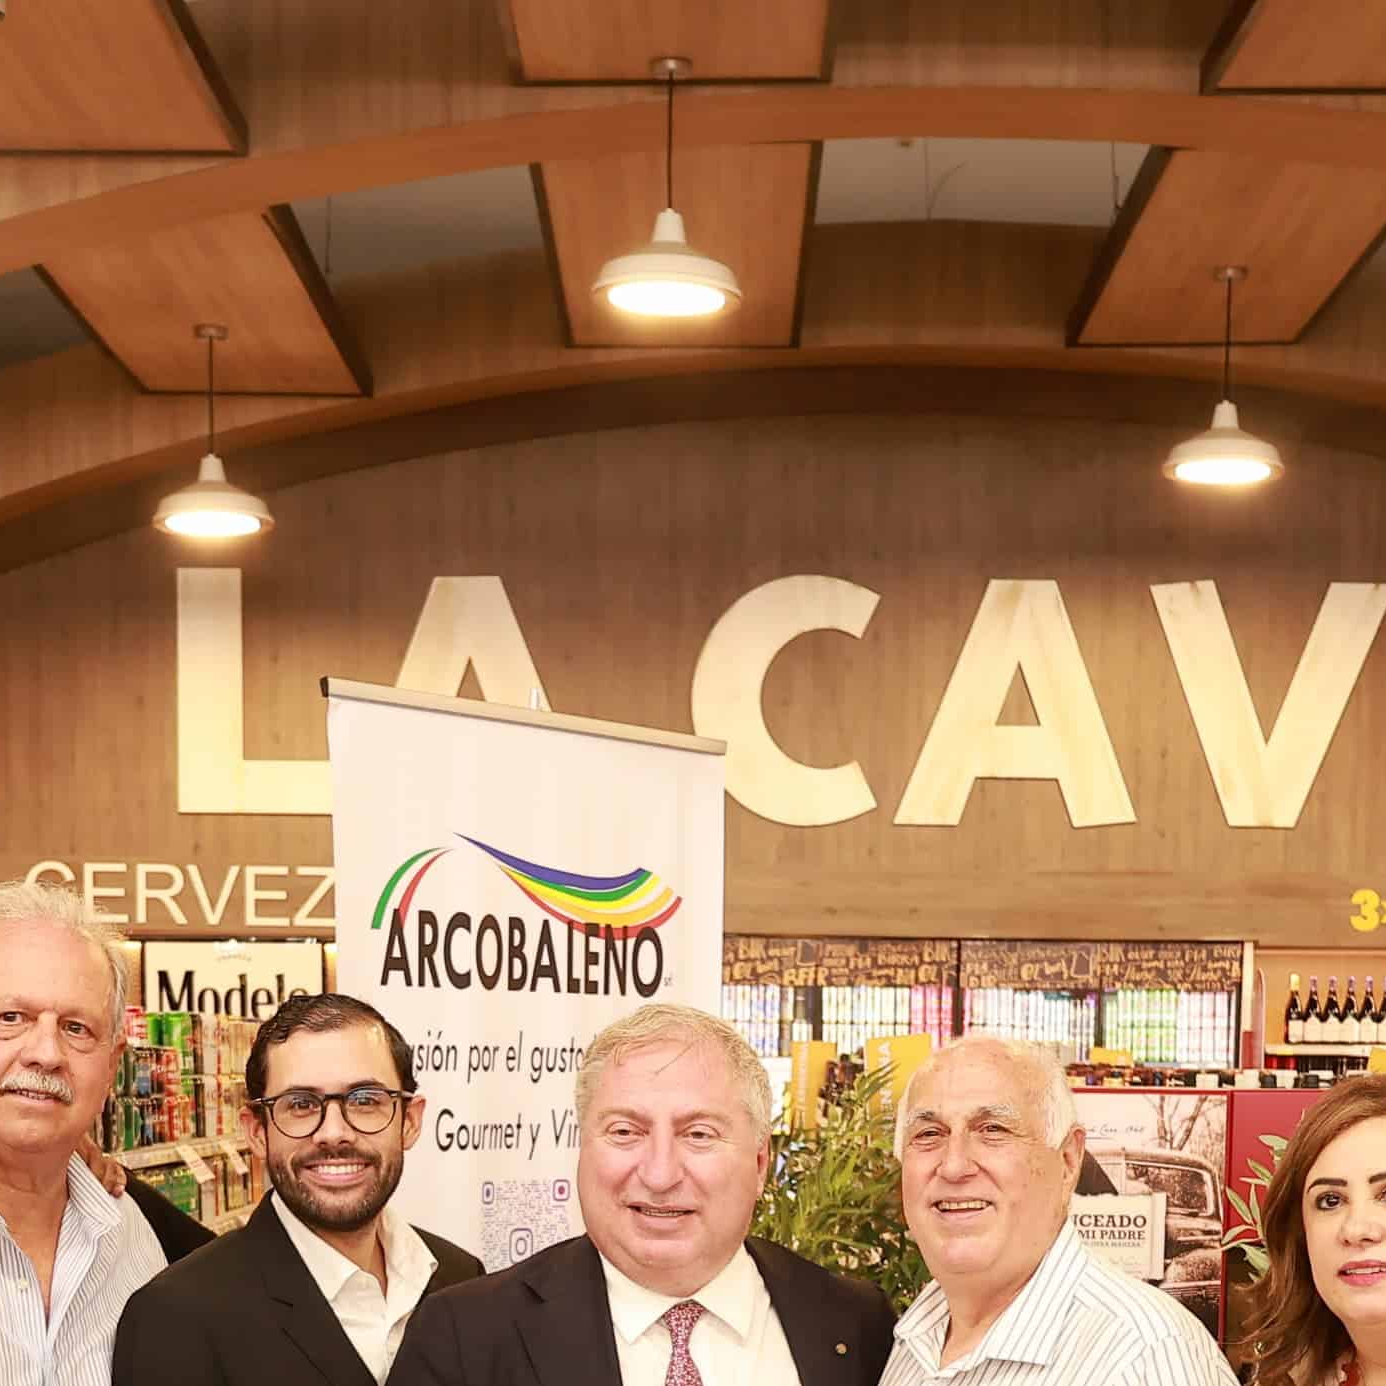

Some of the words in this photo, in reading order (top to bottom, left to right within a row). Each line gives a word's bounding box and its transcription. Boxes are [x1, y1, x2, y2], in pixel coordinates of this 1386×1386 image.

[380, 907, 664, 998] ARCOBALENO
[157, 969, 309, 1019] Model
[412, 1030, 458, 1073] sión
[466, 1043, 500, 1084] por
[506, 1030, 523, 1073] el
[435, 1107, 522, 1153] Gourmet
[528, 1122, 541, 1161] y
[1077, 1229, 1097, 1241] MI
[1100, 1229, 1147, 1241] PADRE
